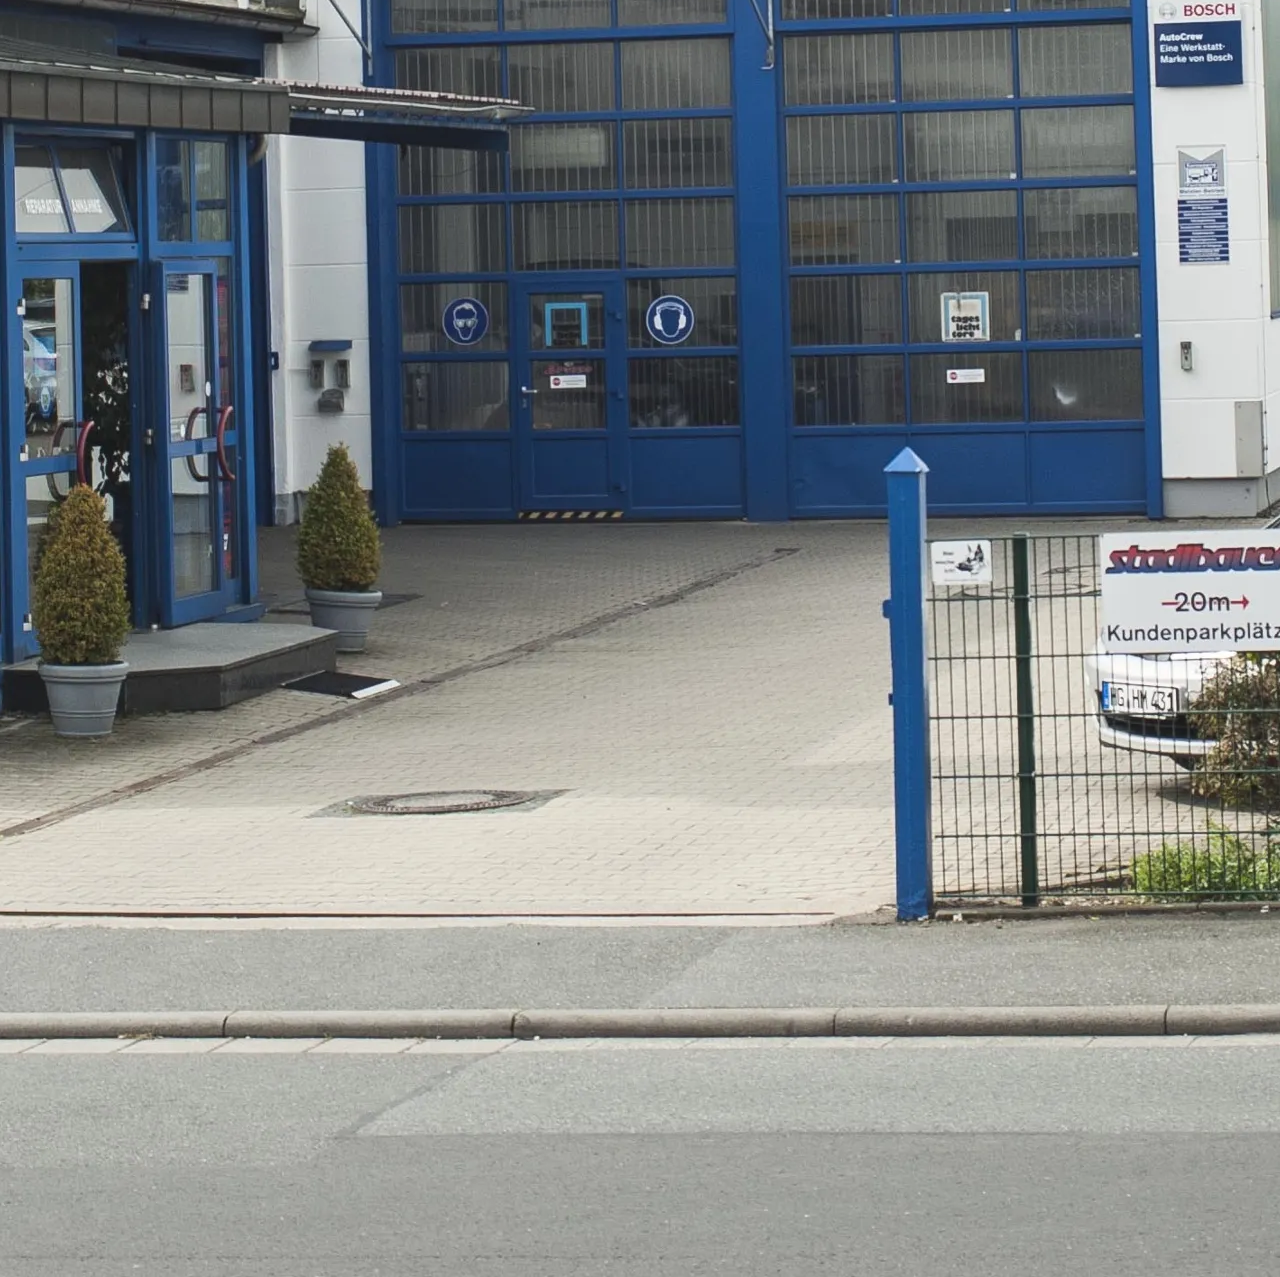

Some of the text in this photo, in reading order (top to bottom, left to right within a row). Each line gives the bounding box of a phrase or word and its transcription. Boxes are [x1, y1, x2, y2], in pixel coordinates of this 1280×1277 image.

[1183, 3, 1235, 17] BOSCH
[1159, 32, 1203, 42] AutoCrew
[1160, 44, 1179, 53] Eine
[1160, 55, 1187, 63] Marke
[1206, 53, 1233, 62] Bosch
[951, 315, 980, 323] tages
[956, 323, 981, 331] licht
